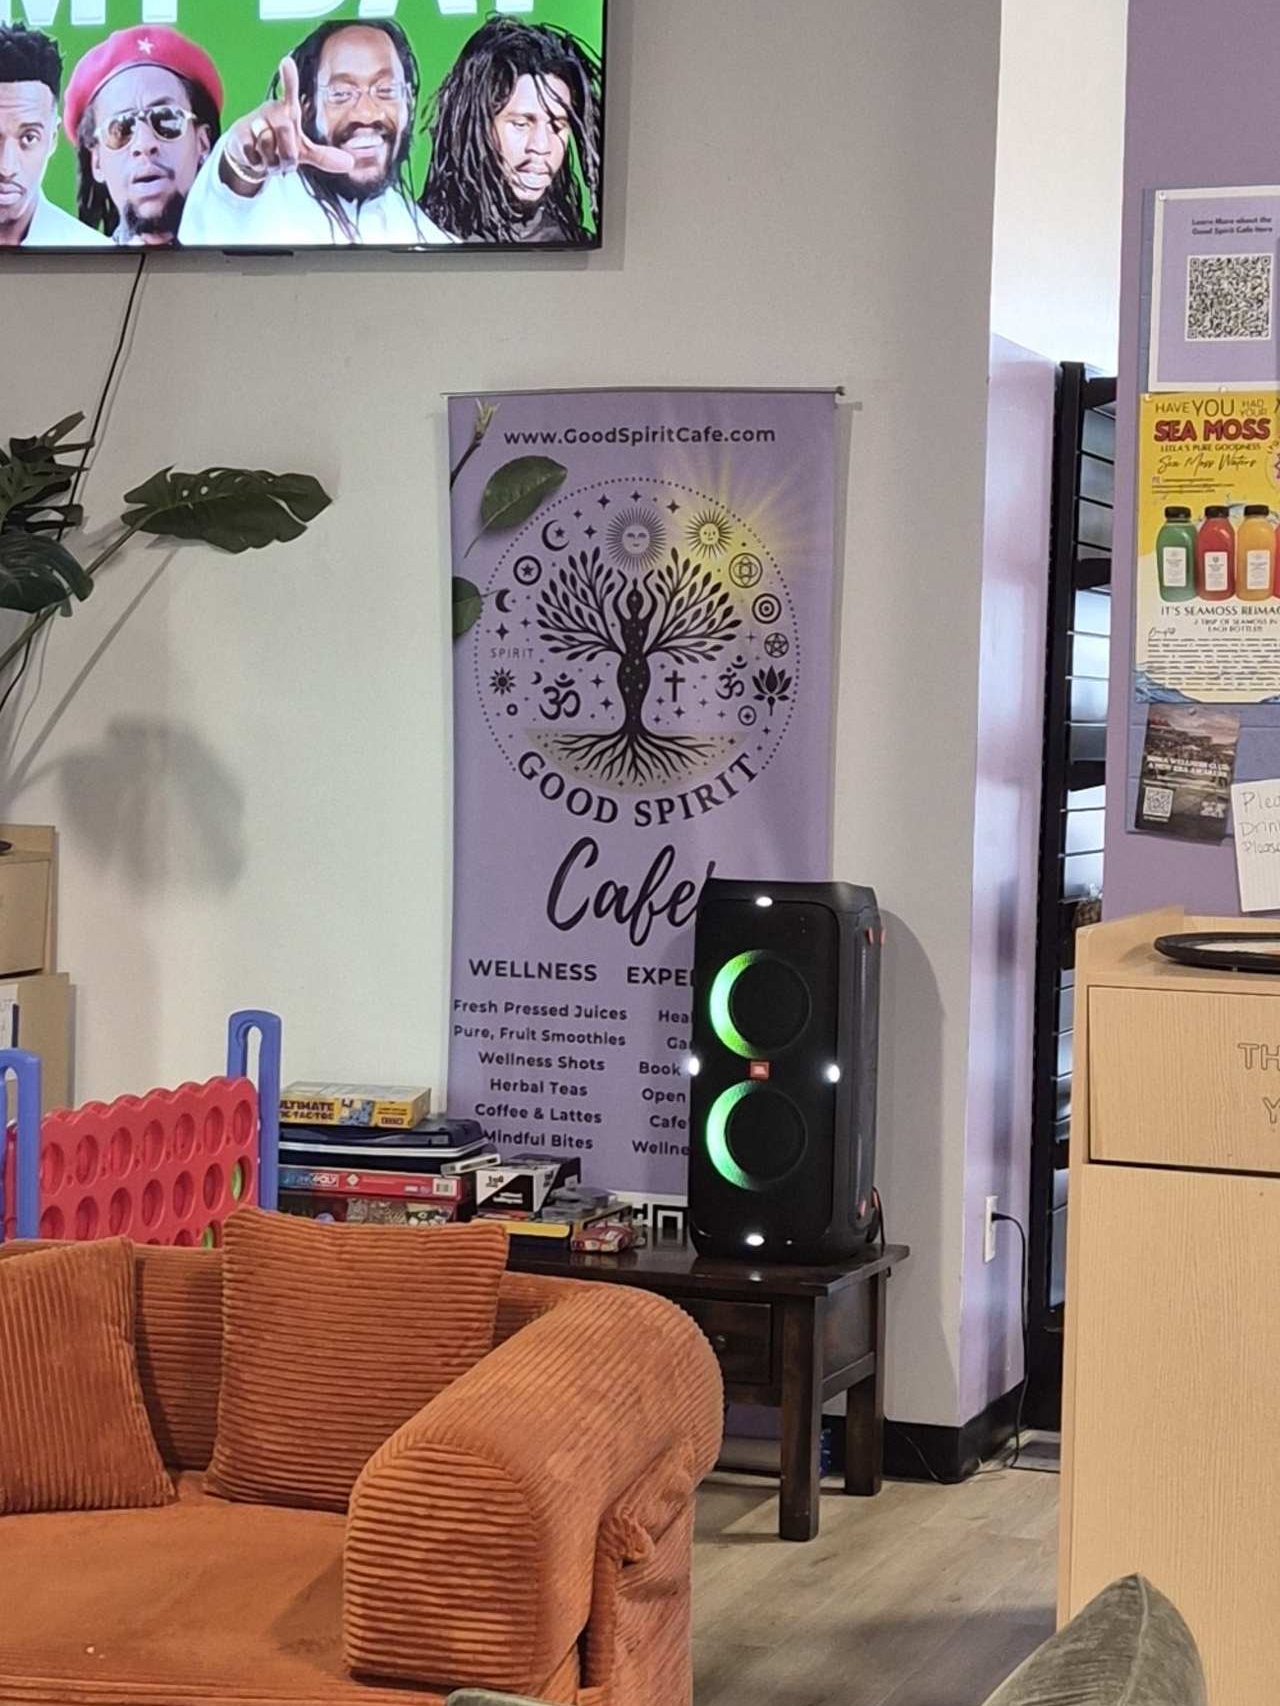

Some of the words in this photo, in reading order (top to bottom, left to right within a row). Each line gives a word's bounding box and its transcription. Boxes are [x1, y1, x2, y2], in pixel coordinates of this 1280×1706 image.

[1155, 400, 1191, 414] HAVE
[1192, 398, 1235, 417] YOU
[503, 425, 777, 446] www.GoodSpiritCafe.com
[1153, 420, 1198, 442] SEA
[1203, 418, 1271, 441] MOSS
[1161, 606, 1181, 616] IT'S
[1184, 605, 1238, 616] SEAMOSS
[489, 646, 534, 659] SPIRIT
[518, 749, 619, 824] GOOD
[634, 752, 761, 827] SPIRIT
[469, 958, 598, 981] WELLNESS
[453, 999, 498, 1014] Fresh
[504, 1001, 569, 1018] Pressed
[574, 1005, 628, 1021] Juices
[658, 1009, 693, 1024] Hea
[453, 1025, 495, 1041] Pure,
[500, 1026, 536, 1042] Fruit
[541, 1029, 626, 1046] Smoothies
[478, 1051, 553, 1068] Wellness
[557, 1055, 605, 1071] Shots
[639, 1061, 682, 1076] Book
[490, 1078, 544, 1092] Herbal
[549, 1081, 588, 1096] Teas
[641, 1087, 686, 1105] Open
[474, 1103, 529, 1119] Coffee
[533, 1107, 545, 1120] &
[550, 1108, 602, 1123] Lattes
[483, 1129, 545, 1146] Mindful
[551, 1132, 593, 1149] Bites
